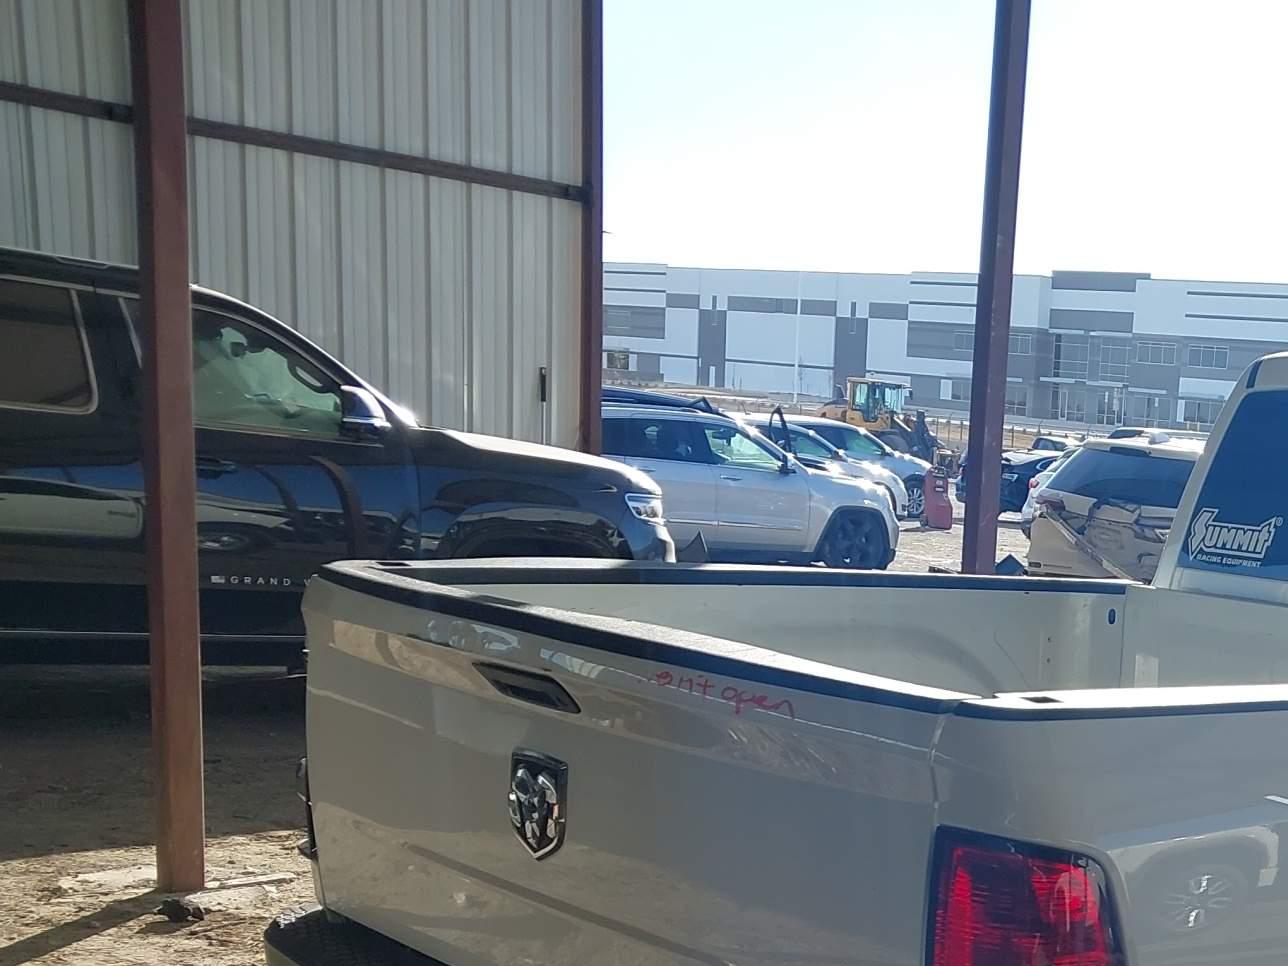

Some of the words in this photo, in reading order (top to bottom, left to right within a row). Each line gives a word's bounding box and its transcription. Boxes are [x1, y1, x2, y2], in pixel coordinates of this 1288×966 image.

[1197, 553, 1221, 564] RACING
[1222, 557, 1262, 568] EQUIPMENT
[230, 575, 291, 587] GRAND
[721, 686, 796, 718] open
